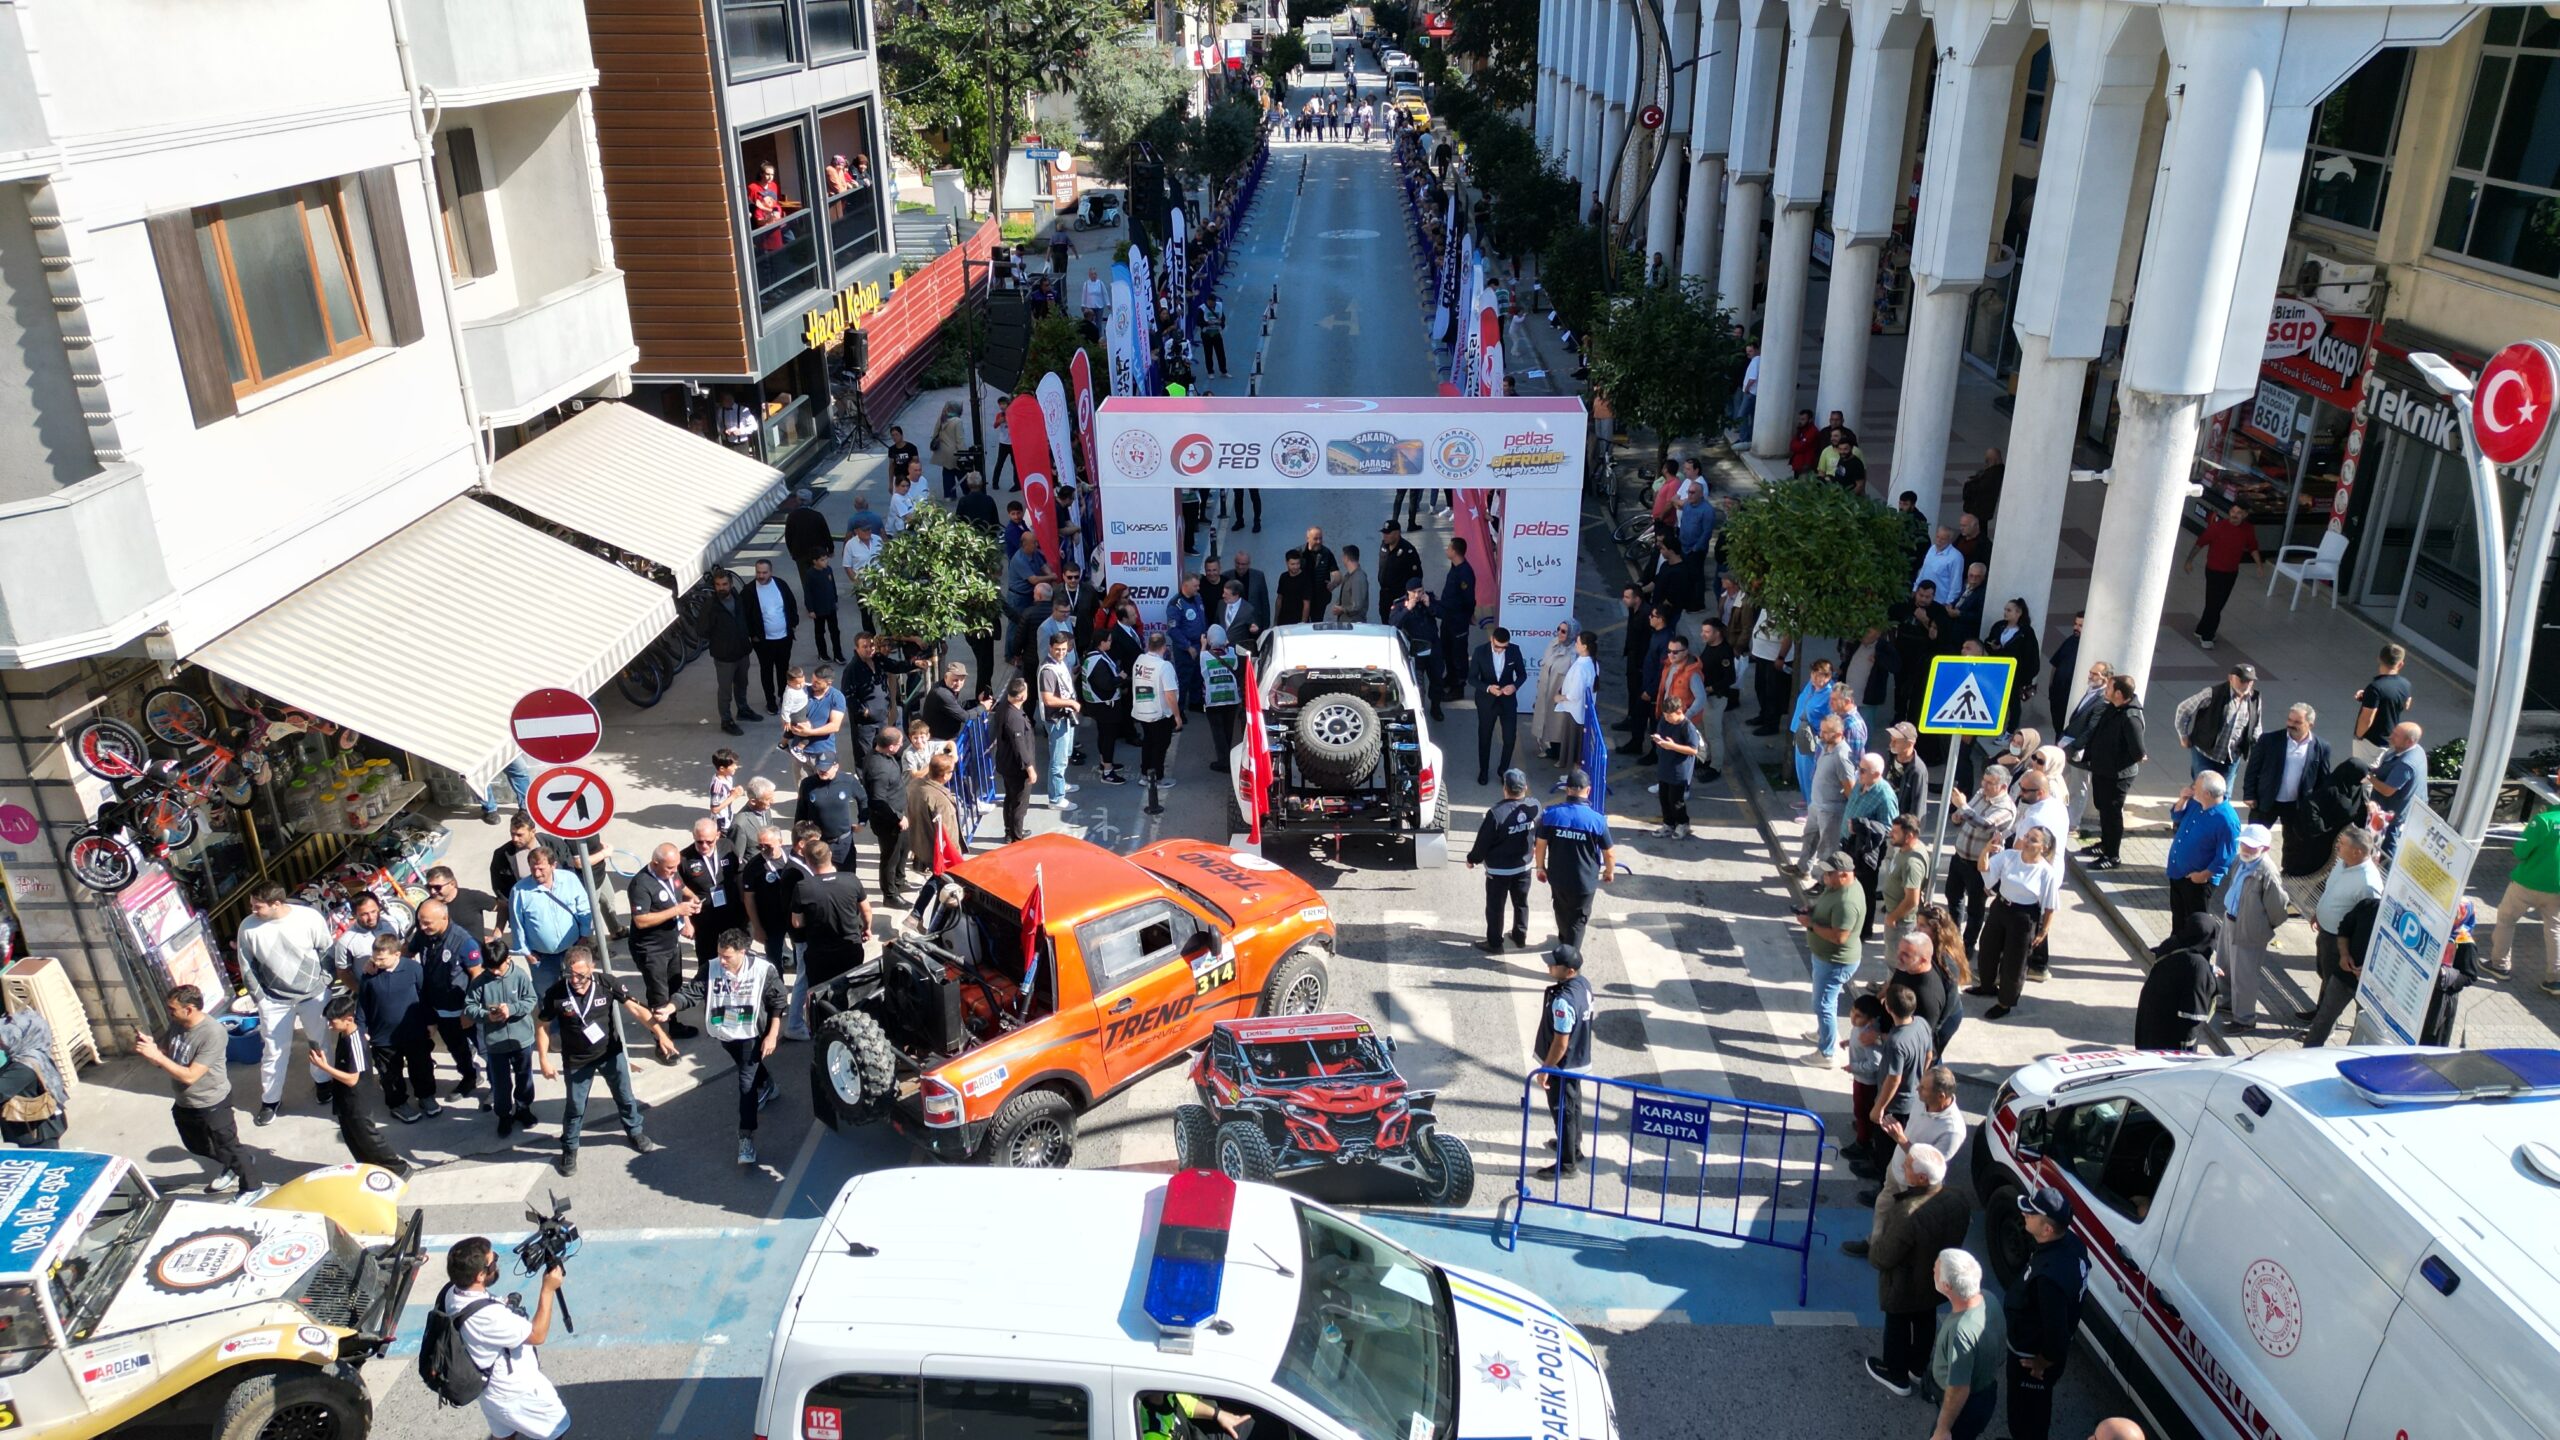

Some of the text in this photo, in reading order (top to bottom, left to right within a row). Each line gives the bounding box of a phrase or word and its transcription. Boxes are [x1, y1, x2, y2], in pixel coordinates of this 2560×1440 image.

[806, 281, 880, 349] Hazal Kebap
[2275, 306, 2305, 319] Bizim
[2267, 321, 2317, 350] sap
[2255, 405, 2280, 433] 850
[2368, 376, 2457, 451] Teknik
[1356, 432, 1395, 444] SAKARYA
[1439, 430, 1476, 442] KARASU
[1504, 431, 1554, 449] petlas
[1218, 443, 1261, 455] TOS
[1218, 457, 1259, 469] FED
[1360, 460, 1391, 469] KARASU
[1492, 452, 1565, 467] OFFROAD
[1126, 524, 1168, 532] KARSAS
[1513, 521, 1570, 538] petlas
[1121, 552, 1161, 565] ARDEN
[1517, 554, 1561, 573] Salados
[1128, 586, 1169, 599] REND
[1508, 820, 1535, 835] ZABITA
[1555, 829, 1587, 841] ZABITA
[1177, 852, 1266, 891] TREND
[713, 977, 731, 994] 54
[1197, 961, 1235, 996] 314
[1105, 993, 1197, 1051] TREND
[973, 1071, 1000, 1092] ARDEN
[1639, 1104, 1705, 1126] KARASU
[1642, 1120, 1699, 1140] ZABITA
[196, 1247, 219, 1272] POWER
[205, 1242, 234, 1278] MECHANIC
[1528, 1318, 1564, 1382] POLİSİ
[95, 1357, 140, 1379] ARDEN
[810, 1410, 836, 1428] 112
